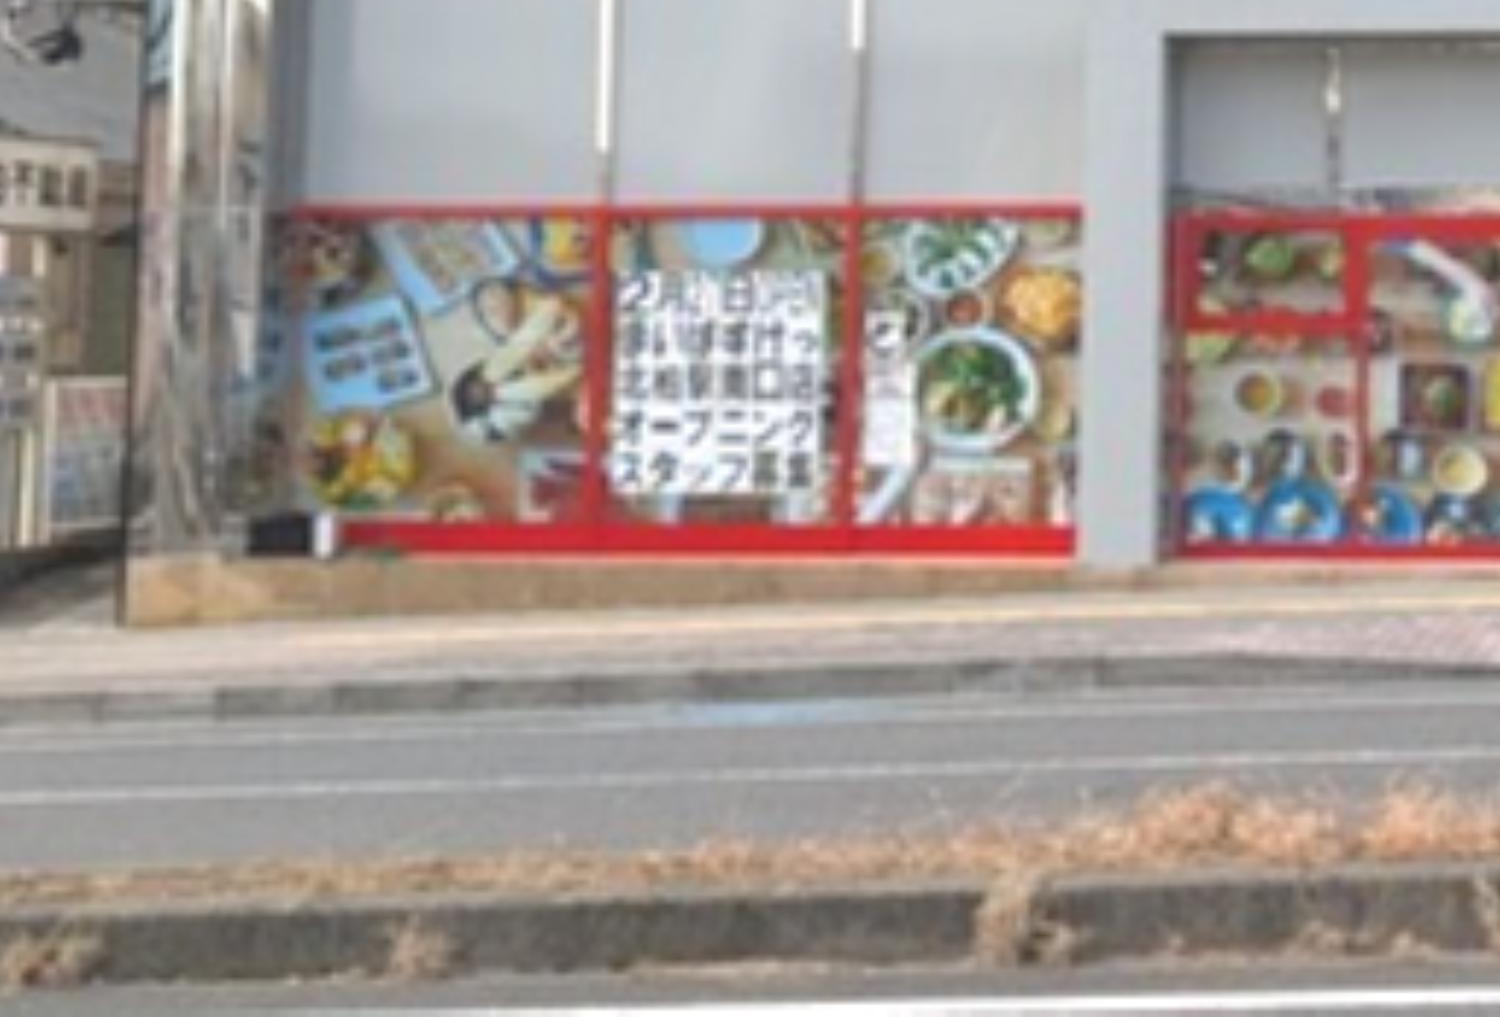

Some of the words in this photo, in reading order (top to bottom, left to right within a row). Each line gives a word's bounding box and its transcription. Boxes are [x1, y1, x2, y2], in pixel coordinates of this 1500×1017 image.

[620, 409, 814, 447] オープニング
